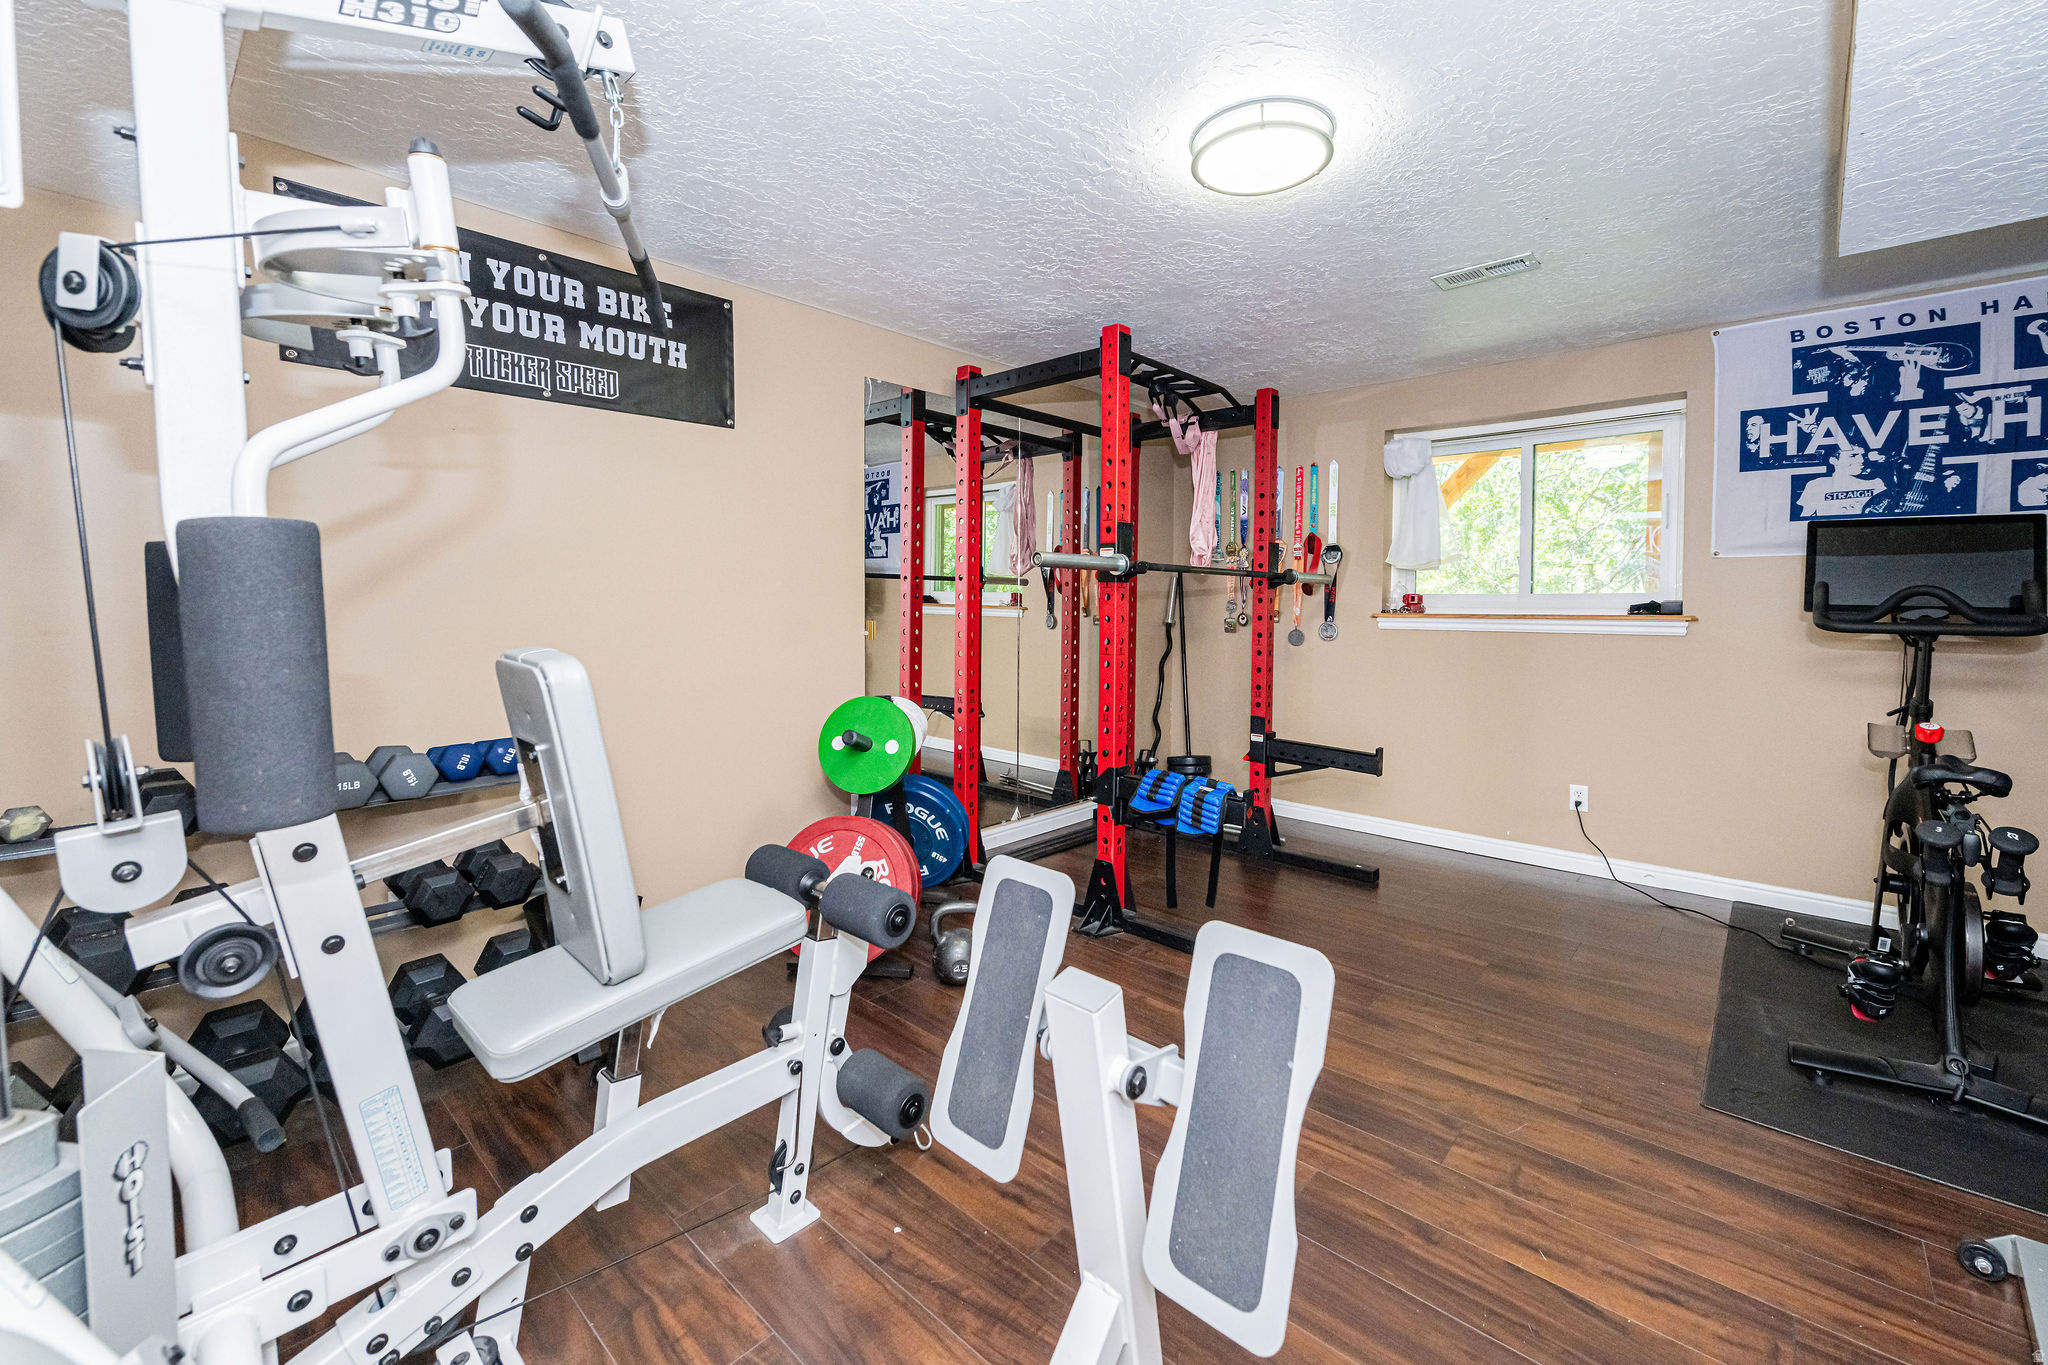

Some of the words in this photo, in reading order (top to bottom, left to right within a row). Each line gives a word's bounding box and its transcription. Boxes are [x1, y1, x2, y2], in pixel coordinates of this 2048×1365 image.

[486, 257, 586, 309] YOUR
[464, 296, 567, 344] YOUR
[578, 320, 688, 369] MOUTH
[1790, 307, 1947, 343] BOSTON
[1981, 292, 2048, 316] HA
[465, 344, 551, 391] TUCKER
[555, 360, 620, 400] SPEED
[1759, 405, 1949, 458] HAVE
[456, 754, 471, 770] 10LB
[502, 747, 516, 764] 10LB
[337, 781, 361, 791] 15LB
[402, 768, 419, 787] 15LB
[931, 851, 948, 863] 45LB
[953, 964, 969, 973] 45
[112, 1140, 149, 1277] HOIST
